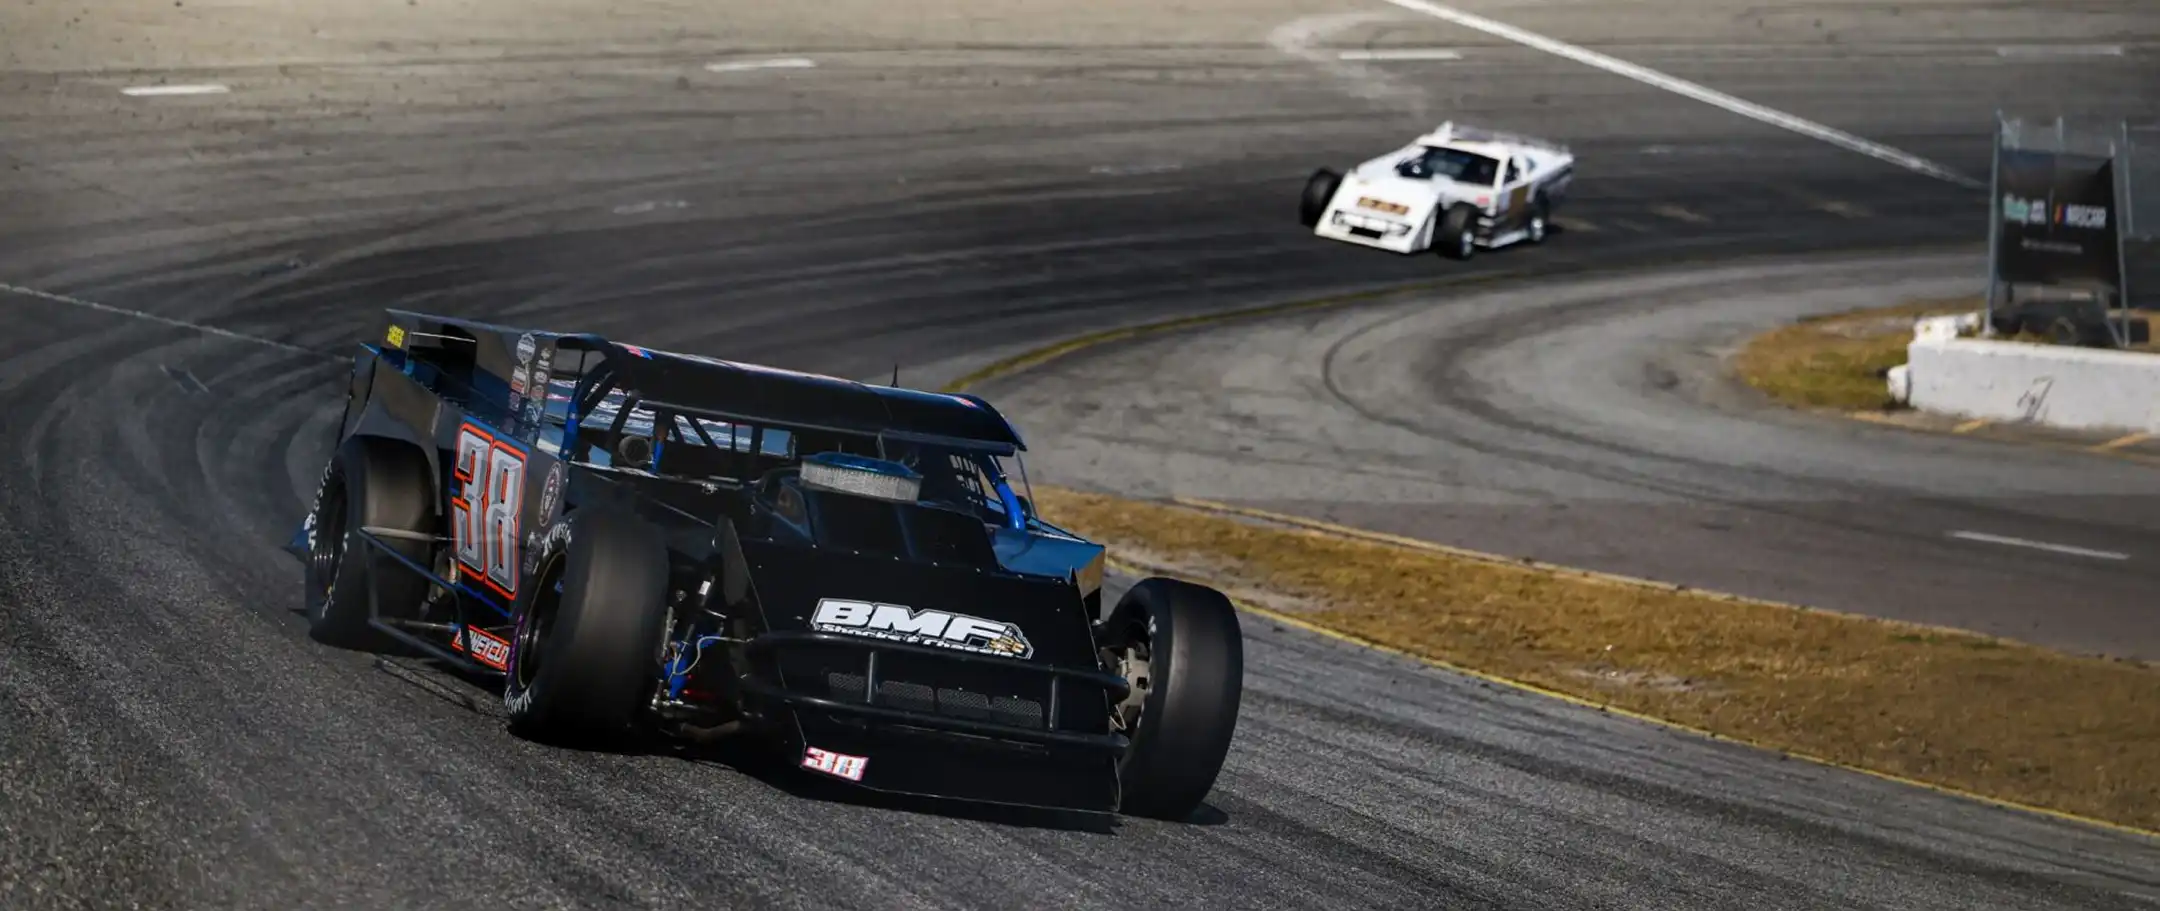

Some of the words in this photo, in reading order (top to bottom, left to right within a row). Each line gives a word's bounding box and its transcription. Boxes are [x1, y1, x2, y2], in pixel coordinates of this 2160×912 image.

[453, 424, 527, 600] 38
[815, 600, 1007, 642] BMF
[802, 746, 869, 781] 38
